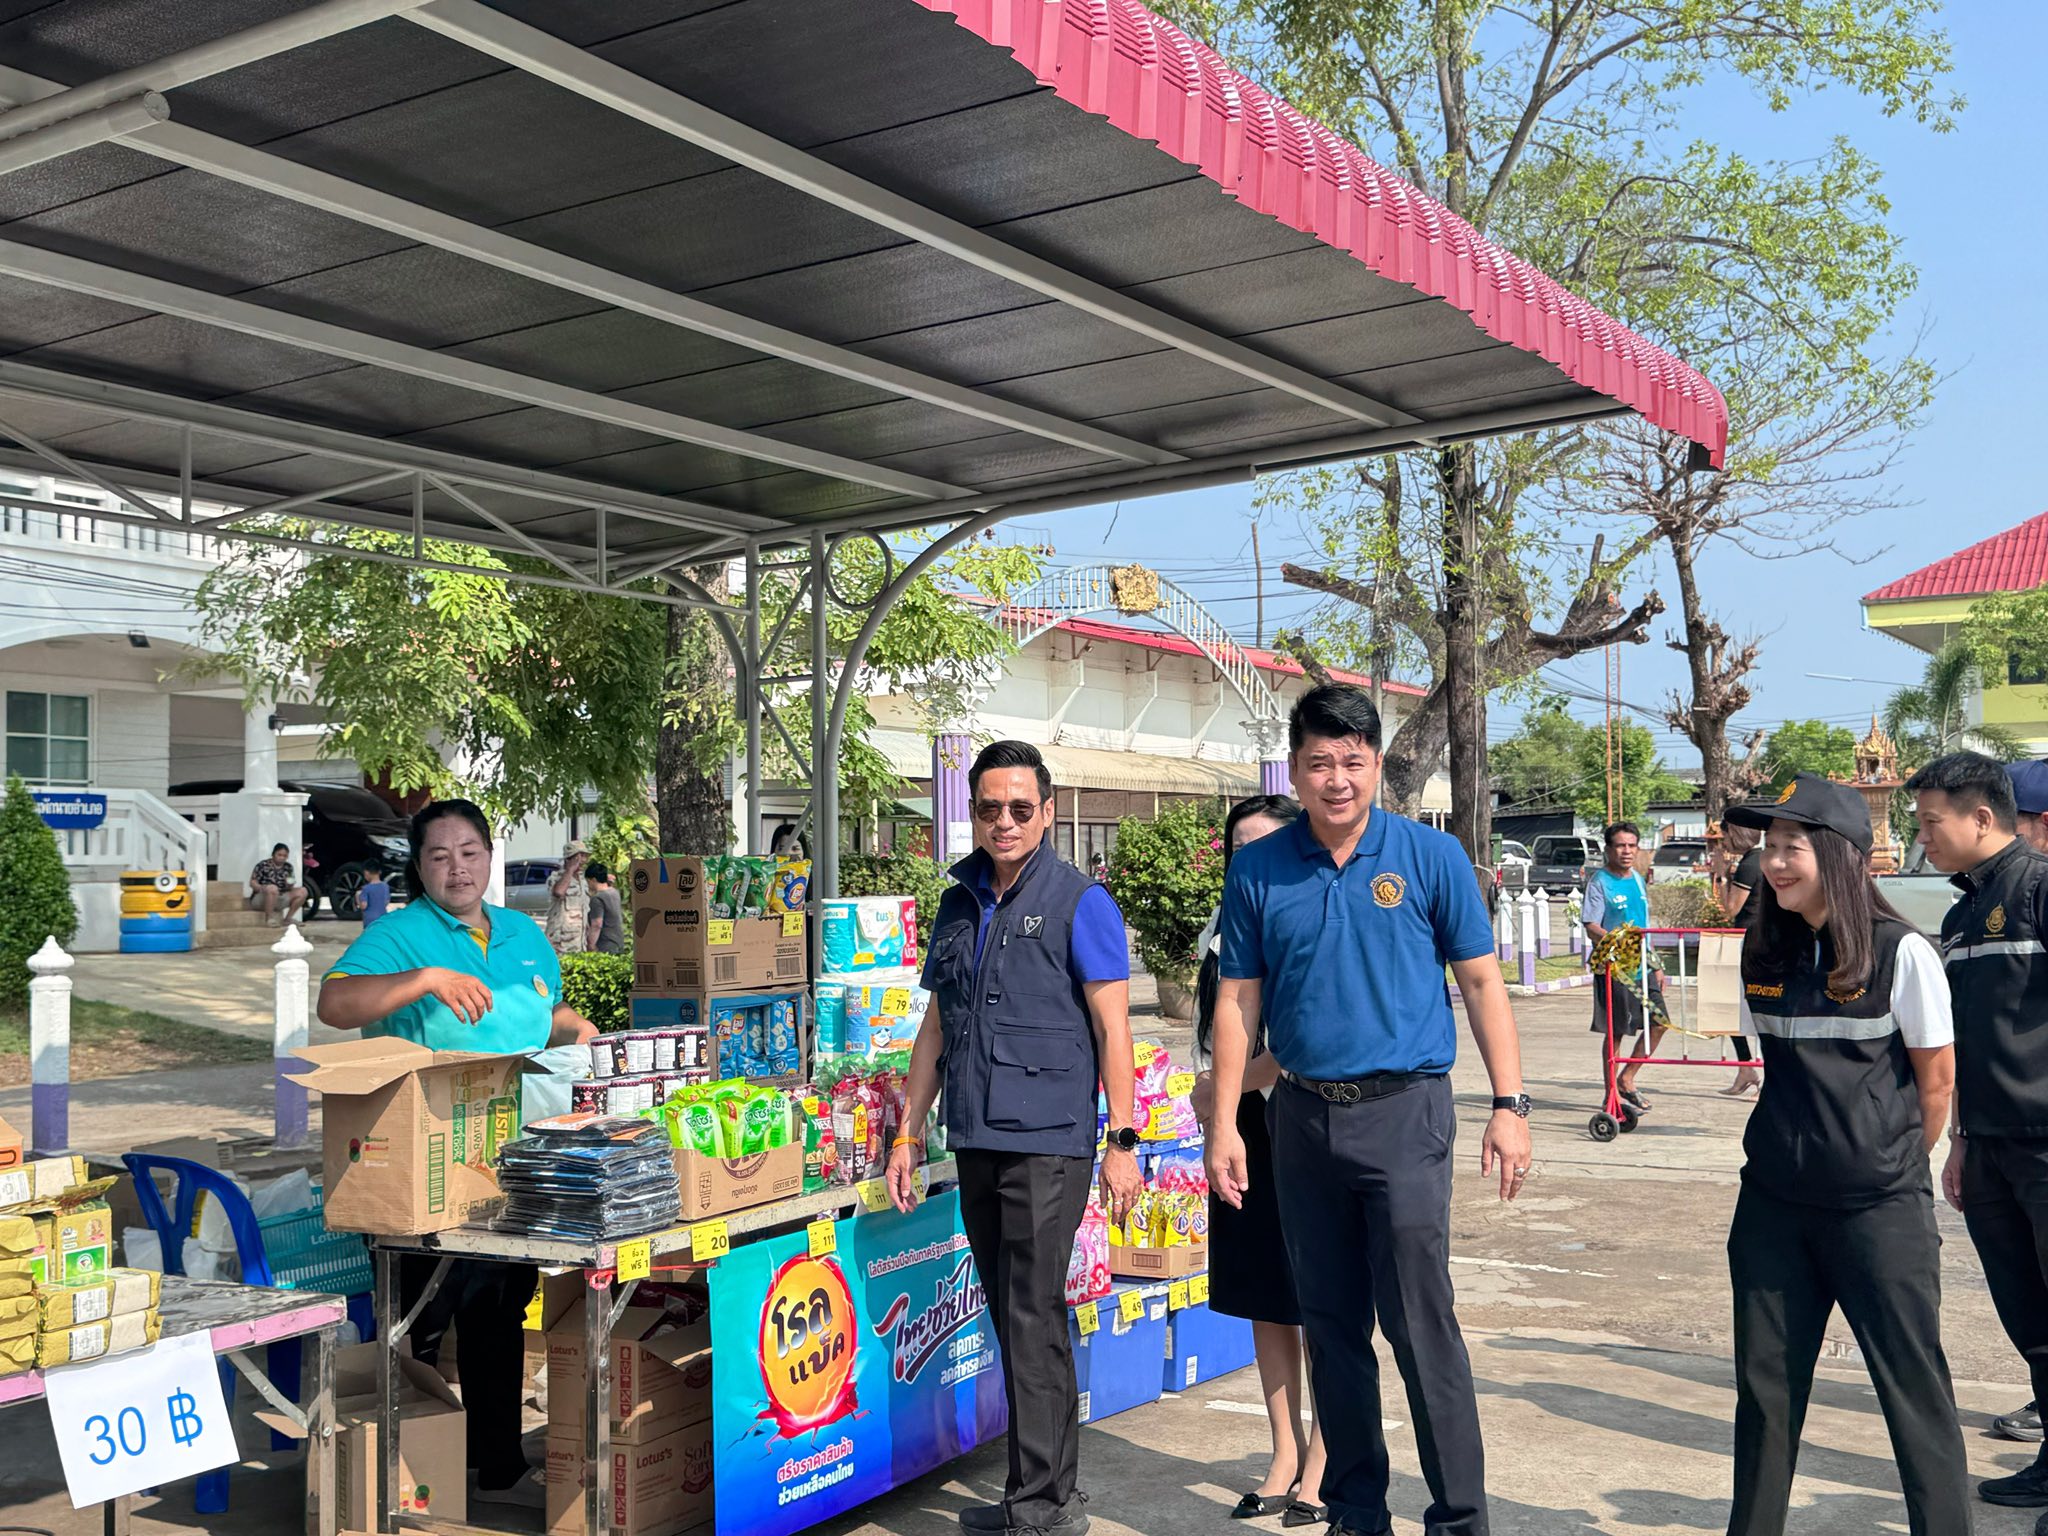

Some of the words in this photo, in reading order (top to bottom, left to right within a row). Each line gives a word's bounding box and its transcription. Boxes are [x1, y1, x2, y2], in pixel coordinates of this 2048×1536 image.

[896, 999, 907, 1011] 79
[1138, 1051, 1153, 1061] 155
[495, 1104, 509, 1155] มรก
[855, 1155, 866, 1167] 30
[875, 1194, 887, 1204] 111
[311, 1226, 358, 1245] Lotus
[711, 1235, 727, 1250] 20
[823, 1234, 835, 1247] 111
[631, 1259, 642, 1270] ฟรี
[644, 1259, 648, 1268] 1
[1095, 1268, 1105, 1292] 3
[1132, 1301, 1142, 1313] 49
[771, 1288, 832, 1360] โรล
[550, 1344, 578, 1356] Lotus's
[789, 1329, 845, 1385] แบ็ค
[84, 1406, 147, 1465] 30
[547, 1450, 575, 1461] Lotus's
[636, 1447, 673, 1469] Lotus's
[777, 1436, 854, 1484] ตรึงราคาสินค้า
[778, 1462, 854, 1506] ช่วยเหลือคนไทย
